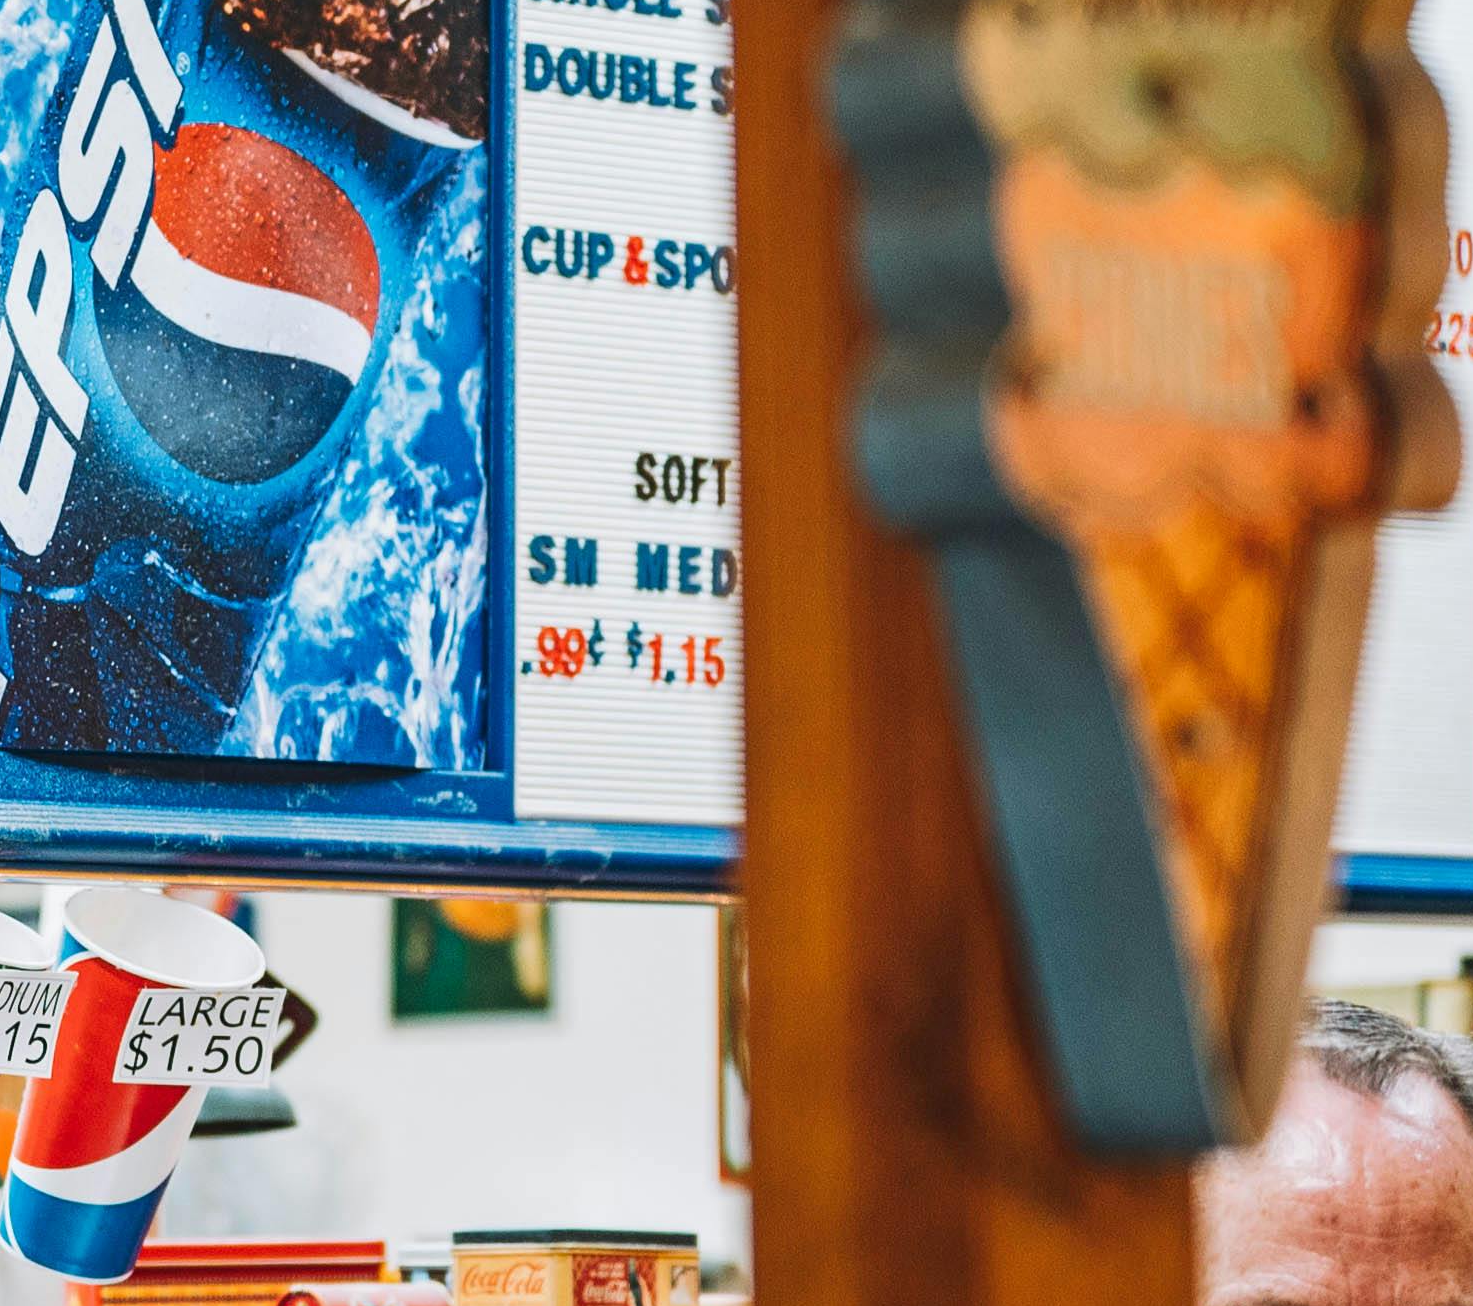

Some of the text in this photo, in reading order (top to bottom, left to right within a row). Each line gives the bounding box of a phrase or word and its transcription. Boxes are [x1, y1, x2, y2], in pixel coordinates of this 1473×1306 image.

[524, 42, 698, 110] DOUBLE
[522, 226, 615, 280] CUP
[634, 452, 732, 507] SOFT
[529, 535, 737, 598] SM MED
[627, 620, 726, 688] $1.15
[137, 995, 274, 1029] LARGE
[122, 1031, 265, 1076] $1.50
